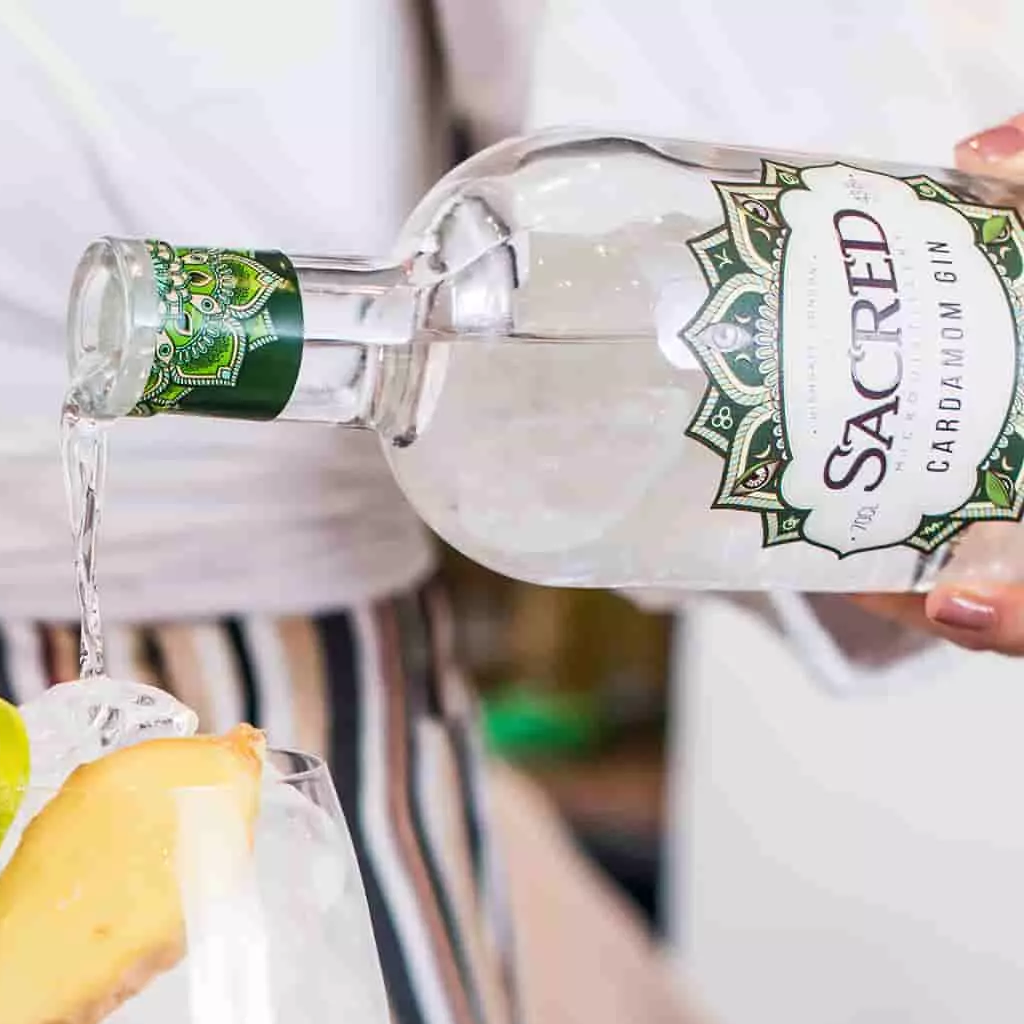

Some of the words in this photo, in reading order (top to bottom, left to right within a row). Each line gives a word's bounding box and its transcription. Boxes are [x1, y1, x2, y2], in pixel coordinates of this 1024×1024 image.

[926, 240, 958, 283] GIN
[823, 209, 903, 492] SACRED
[926, 301, 965, 473] CARDAMOM
